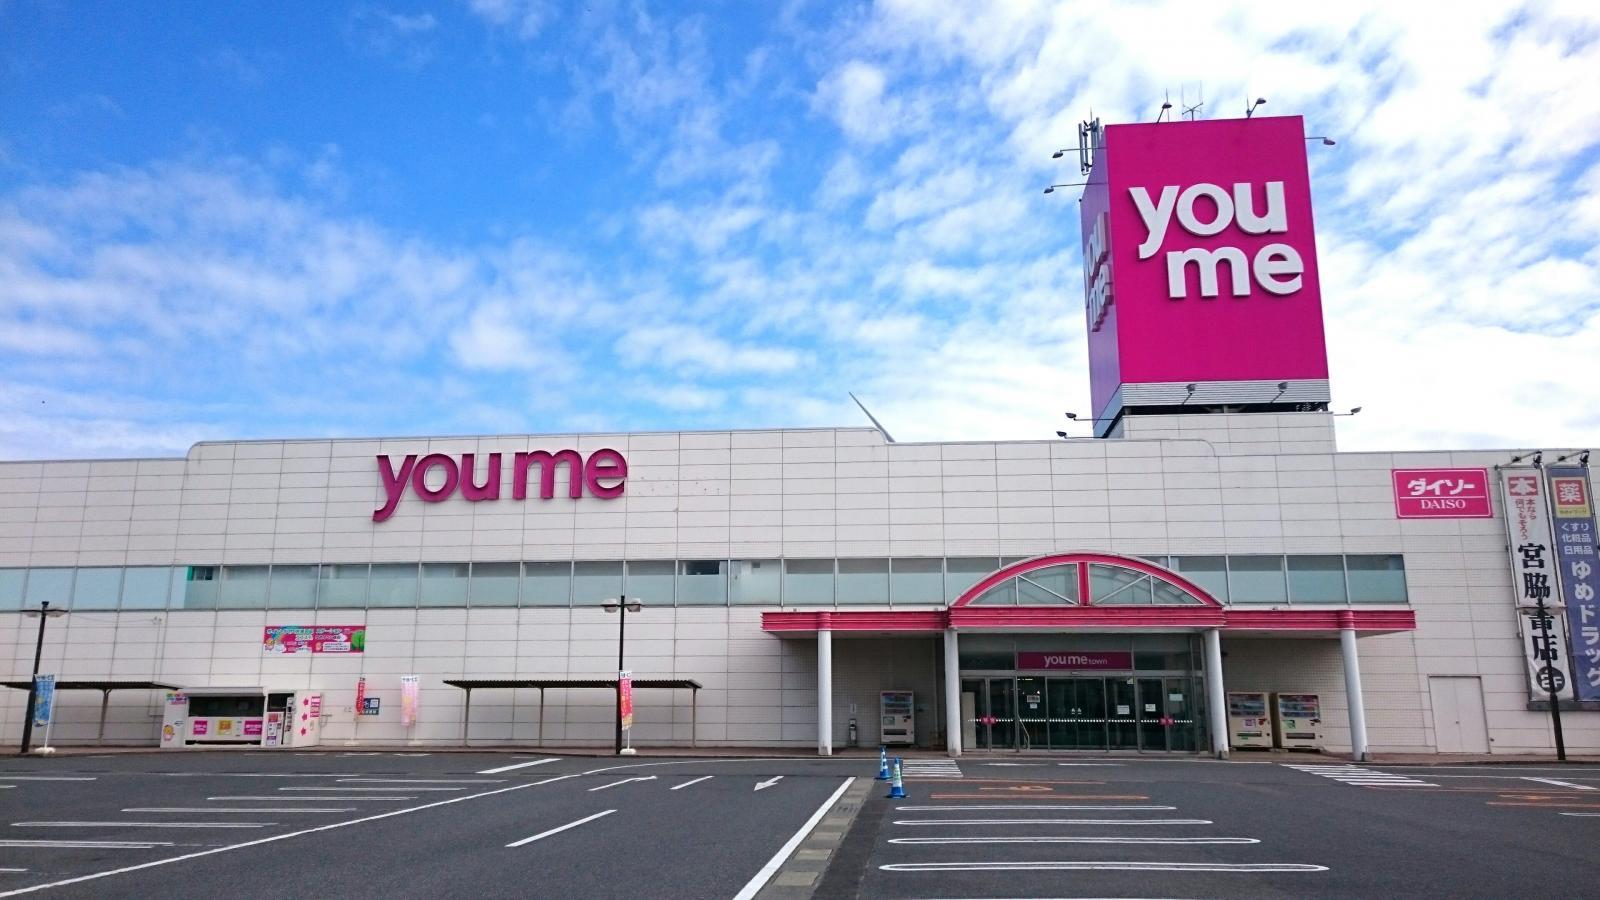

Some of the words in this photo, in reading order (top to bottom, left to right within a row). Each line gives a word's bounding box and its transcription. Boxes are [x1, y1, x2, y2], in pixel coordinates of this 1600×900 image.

[1128, 181, 1288, 259] you
[1167, 243, 1304, 299] me
[1407, 478, 1475, 496] ダイソー
[1509, 477, 1537, 496] 本
[1558, 481, 1581, 503] 薬
[1421, 499, 1466, 509] DAISO
[1561, 523, 1590, 532] くすり
[1562, 534, 1592, 543] 化粧品
[1564, 546, 1594, 555] 日用品
